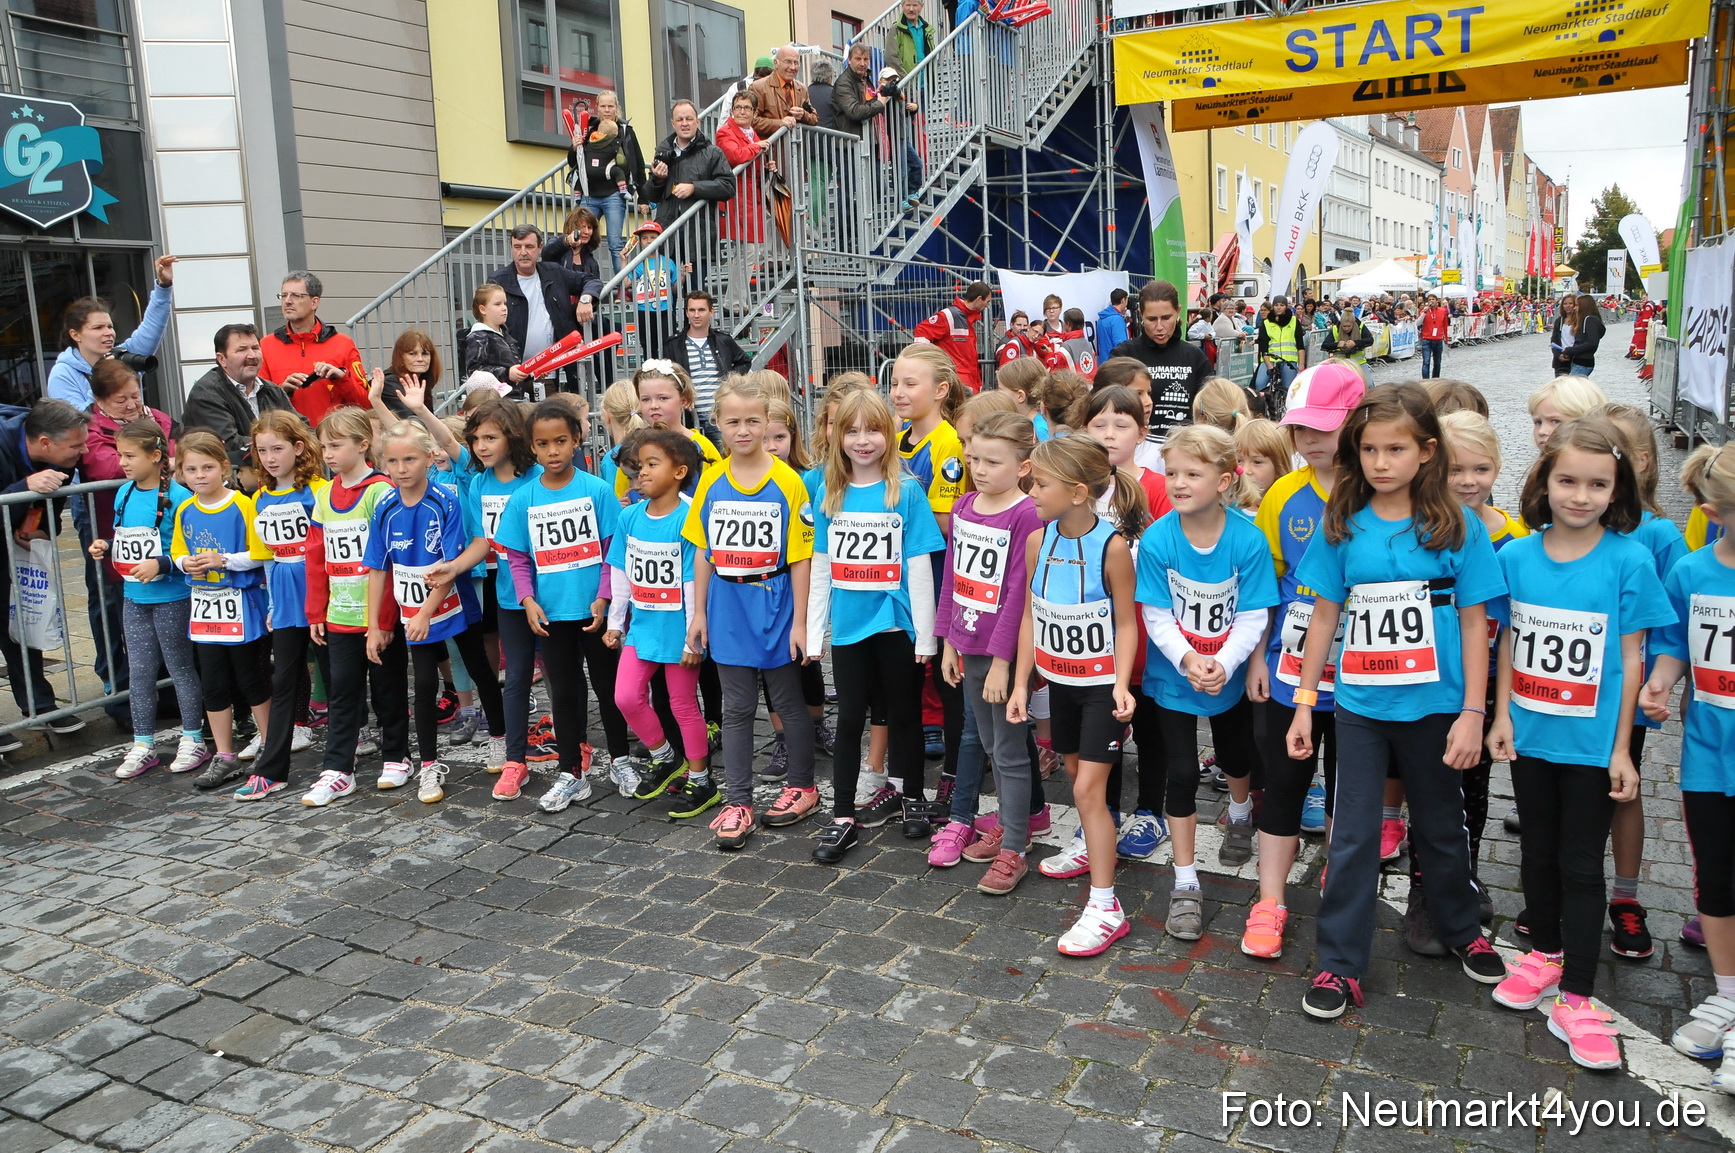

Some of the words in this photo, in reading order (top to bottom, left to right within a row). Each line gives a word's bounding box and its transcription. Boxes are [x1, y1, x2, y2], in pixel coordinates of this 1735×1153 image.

[1523, 16, 1601, 36] Neumarkter
[1603, 4, 1669, 24] Stadtlauf
[1285, 6, 1484, 72] START
[1143, 65, 1202, 79] Neumarkter
[1206, 59, 1253, 73] Stadtlauf
[1533, 63, 1600, 77] Neumarkter
[1602, 55, 1658, 70] Stadtlauf
[1195, 97, 1248, 111] Neumarkter
[1249, 92, 1293, 104] Stadtlauf
[4, 122, 63, 195] G2
[1284, 225, 1300, 262] Audi
[1295, 189, 1309, 221] BKK
[1506, 283, 1513, 291] A
[524, 358, 536, 369] Audi
[536, 352, 547, 362] BKK
[551, 353, 568, 364] Audi
[568, 348, 582, 357] BKK
[1147, 366, 1192, 374] EUMARKTER
[1150, 372, 1188, 380] TADTLAUF
[940, 486, 963, 496] PARTL
[270, 508, 300, 517] Neumarkt
[547, 506, 582, 518] Neumarkt
[731, 508, 767, 517] Neumarkt
[259, 516, 309, 541] 7156
[328, 526, 357, 534] Neumarkt
[536, 515, 592, 547] 7504
[850, 520, 889, 528] Neumarkt
[715, 519, 773, 548] 7203
[960, 528, 994, 545] Neumarkt
[275, 547, 296, 556] Sofia
[636, 548, 668, 556] Neumarkt
[835, 531, 892, 560] 7221
[545, 551, 579, 562] Victoria
[725, 554, 753, 565] Mona
[332, 565, 354, 575] Selina
[394, 570, 411, 579] PARTL
[630, 554, 674, 585] 7503
[843, 567, 880, 579] Carolin
[203, 590, 231, 598] Neumarkt
[1171, 576, 1191, 596] PARTL
[1193, 586, 1233, 600] Neumarkt
[1362, 592, 1410, 604] Neumarkt
[193, 598, 237, 620] 7219
[1032, 602, 1049, 617] PARTL
[1050, 611, 1094, 621] Neumarkt
[1176, 592, 1234, 633] 7183
[1289, 609, 1311, 623] PART
[1693, 605, 1725, 618] PARTL
[205, 624, 222, 633] Jule
[1349, 606, 1424, 646] 7149
[1528, 616, 1584, 632] Neumarkt
[1037, 616, 1105, 655] 7080
[1512, 625, 1592, 677] 7139
[1700, 623, 1735, 665] 71
[1051, 659, 1086, 674] Felina
[1362, 656, 1399, 671] Leoni
[1518, 677, 1559, 699] Selma
[1718, 675, 1735, 693] So
